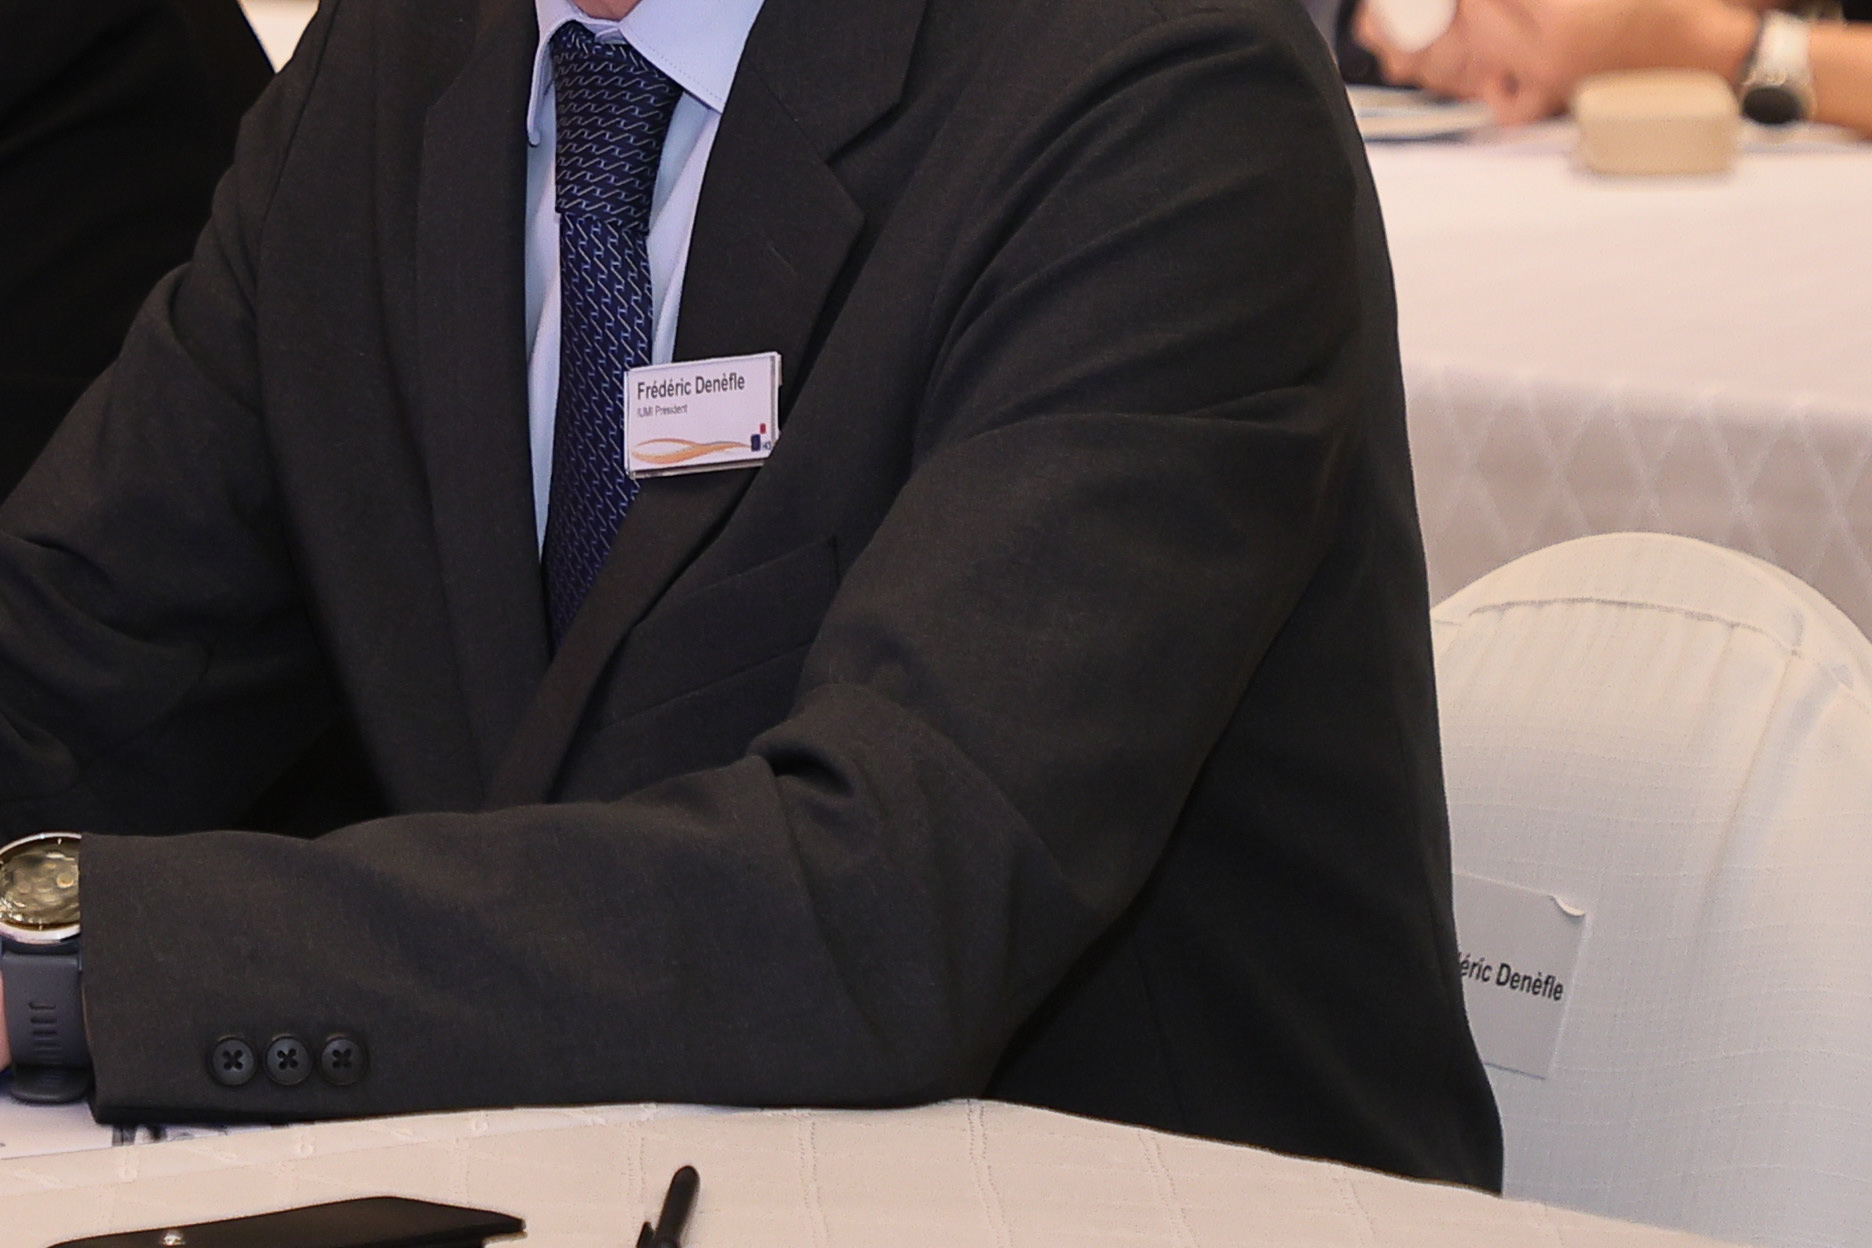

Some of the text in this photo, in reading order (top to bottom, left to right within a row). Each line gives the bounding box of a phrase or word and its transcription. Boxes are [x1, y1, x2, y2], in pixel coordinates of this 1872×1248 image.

[637, 372, 745, 401] Frédéric Denèfle
[655, 403, 689, 417] President
[1459, 952, 1565, 1002] éric Denèfle
